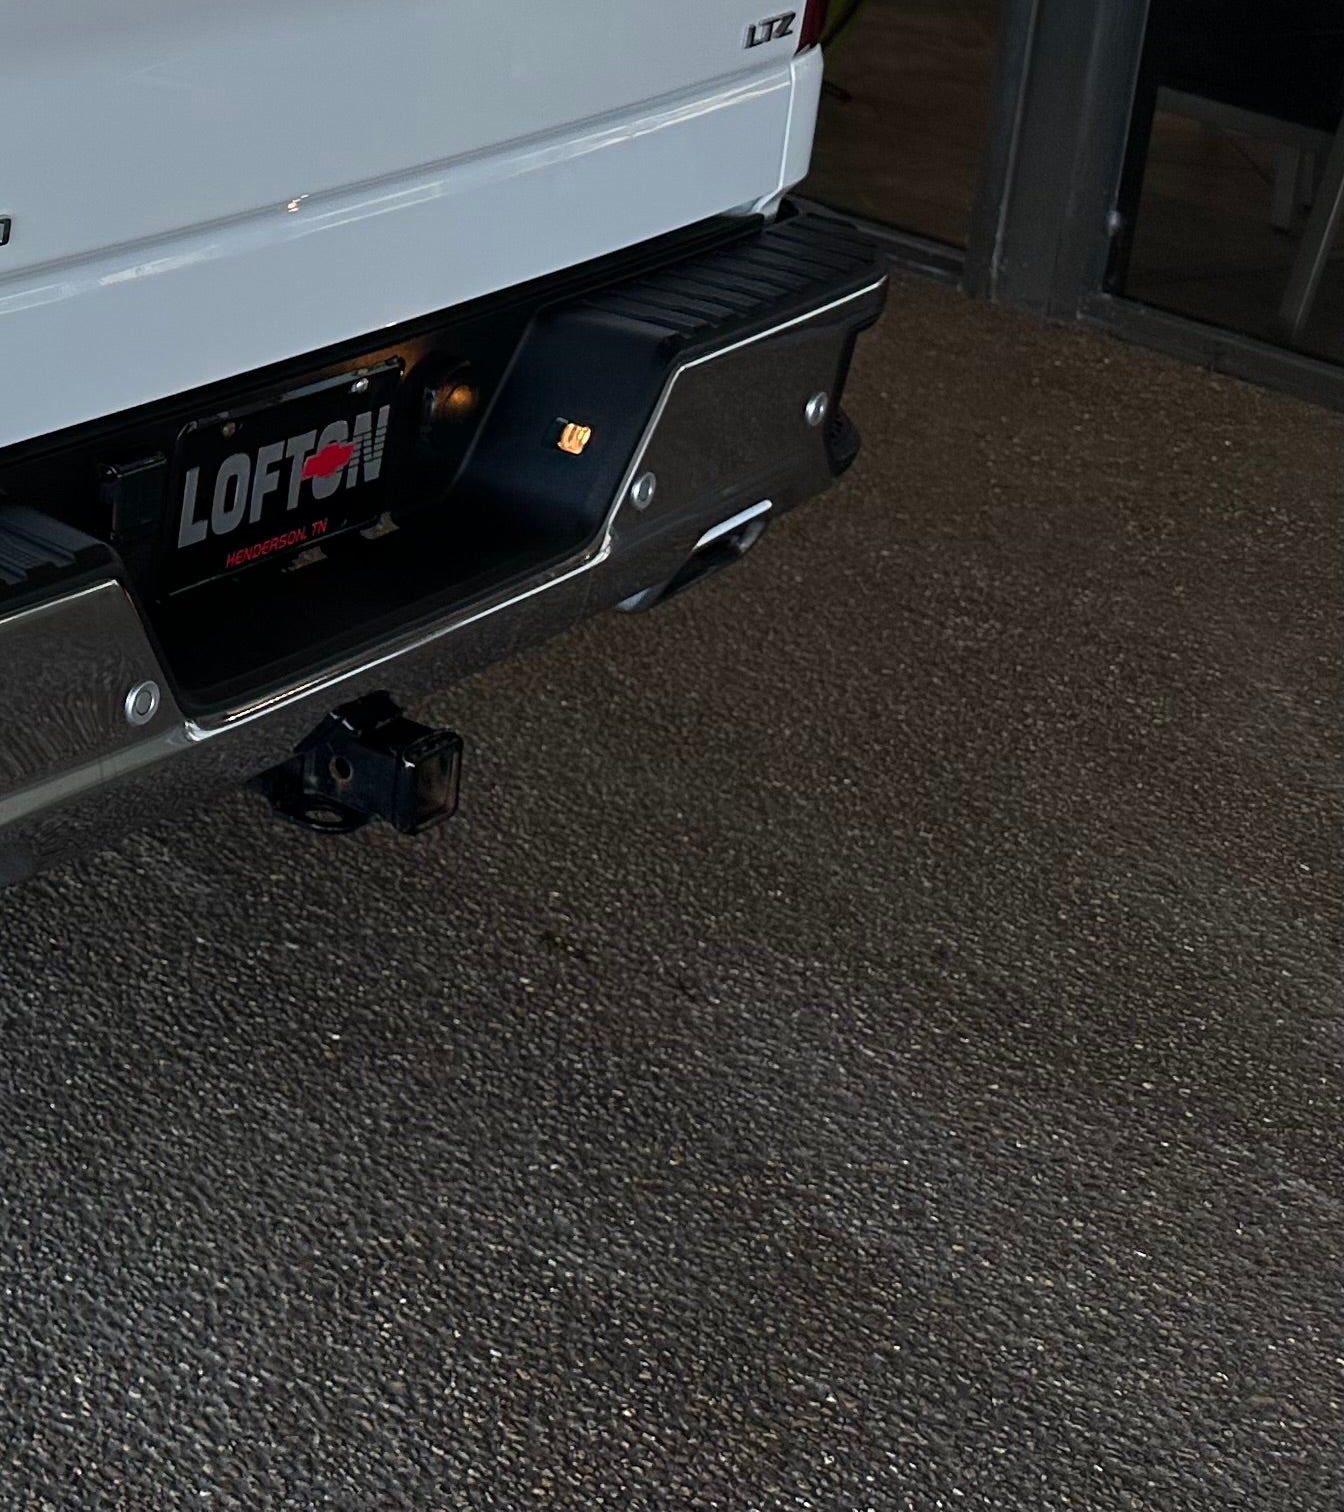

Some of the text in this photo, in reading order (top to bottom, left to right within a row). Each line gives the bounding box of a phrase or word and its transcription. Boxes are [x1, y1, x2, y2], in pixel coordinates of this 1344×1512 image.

[742, 10, 796, 49] LTZ
[177, 404, 391, 549] LOFTON
[311, 519, 329, 536] TN
